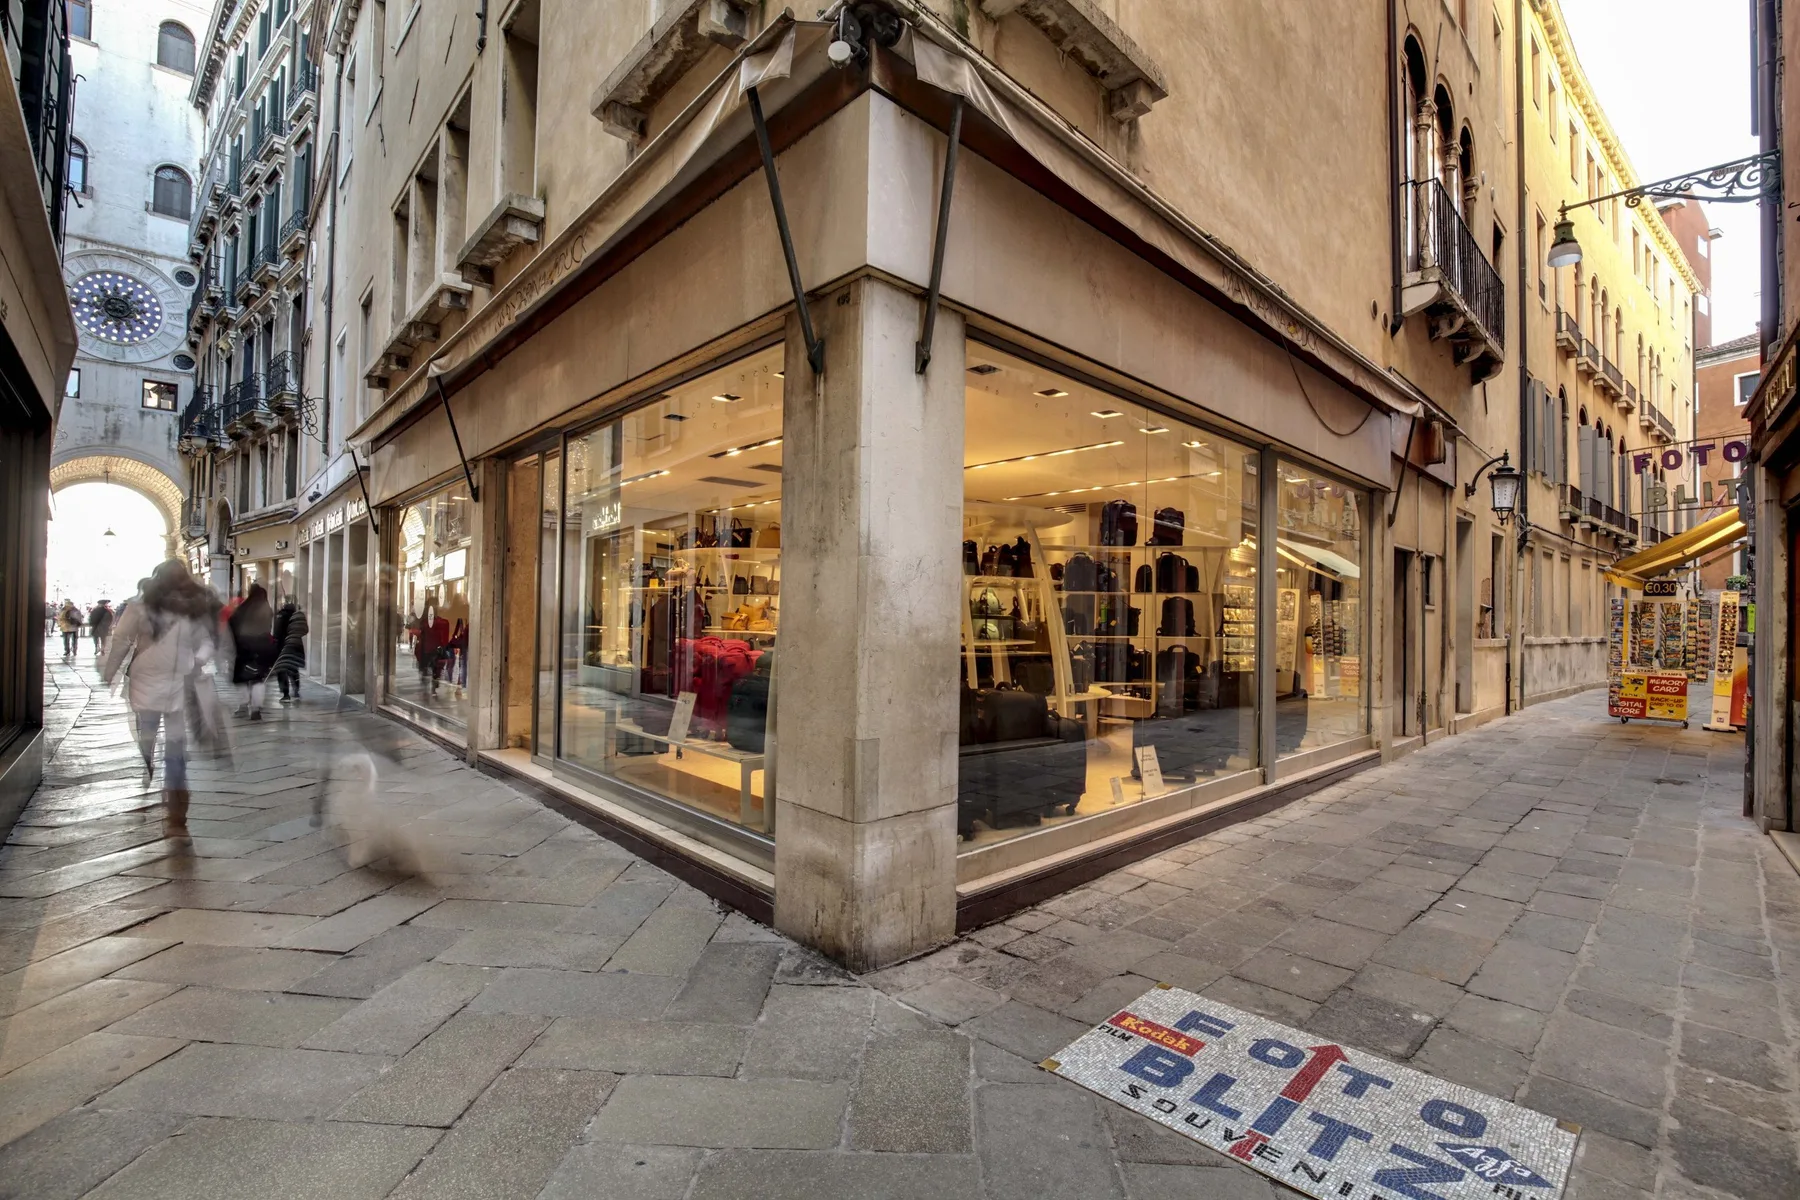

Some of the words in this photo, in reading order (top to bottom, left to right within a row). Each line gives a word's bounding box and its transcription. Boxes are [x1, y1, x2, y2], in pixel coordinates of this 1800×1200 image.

[1633, 441, 1747, 474] FOTO
[1647, 478, 1744, 507] BLIT
[1645, 582, 1676, 594] €0.30
[1649, 678, 1685, 687] MEMORY
[1613, 700, 1644, 708] GITAL
[1613, 707, 1641, 715] STORE
[1097, 1024, 1133, 1042] FILM
[1120, 1015, 1190, 1051] Kodak
[1174, 1008, 1487, 1138] FOTO
[1119, 1044, 1465, 1200] BLITZ
[1120, 1083, 1387, 1200] SOUVENI
[1446, 1147, 1532, 1178] Agfa
[1493, 1182, 1537, 1200] FIL
